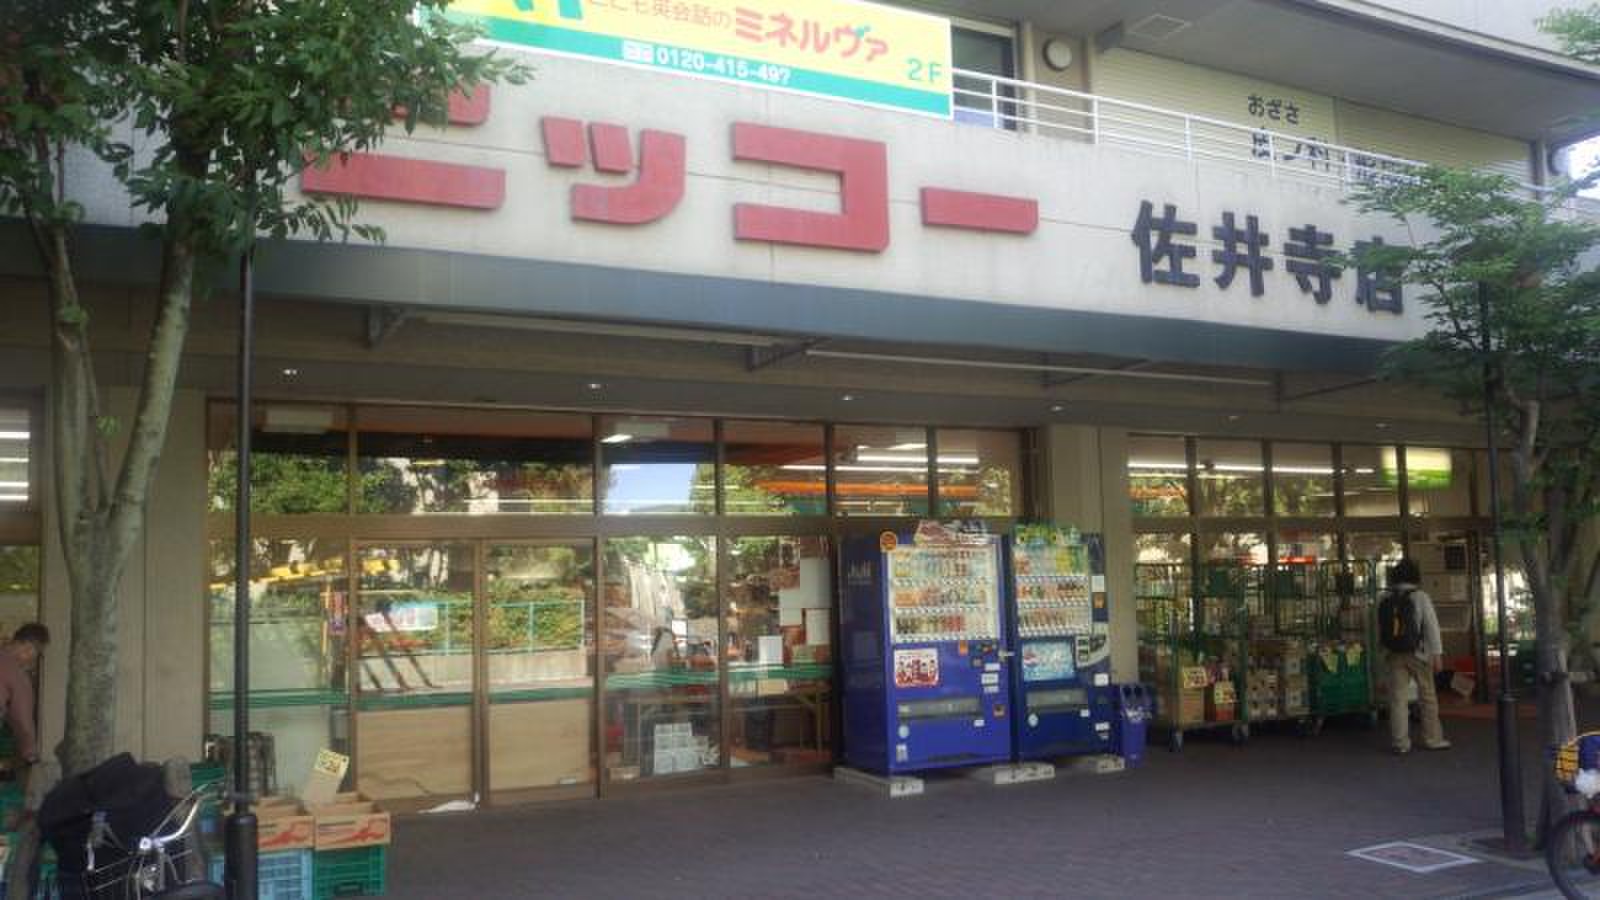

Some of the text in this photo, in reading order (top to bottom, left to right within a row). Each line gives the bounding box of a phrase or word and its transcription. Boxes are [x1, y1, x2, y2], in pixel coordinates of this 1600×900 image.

[735, 7, 890, 62] ミネルヴァ
[656, 47, 791, 86] 0120-415-497
[1248, 95, 1300, 125] おざさ
[1131, 200, 1405, 315] 佐井寺店
